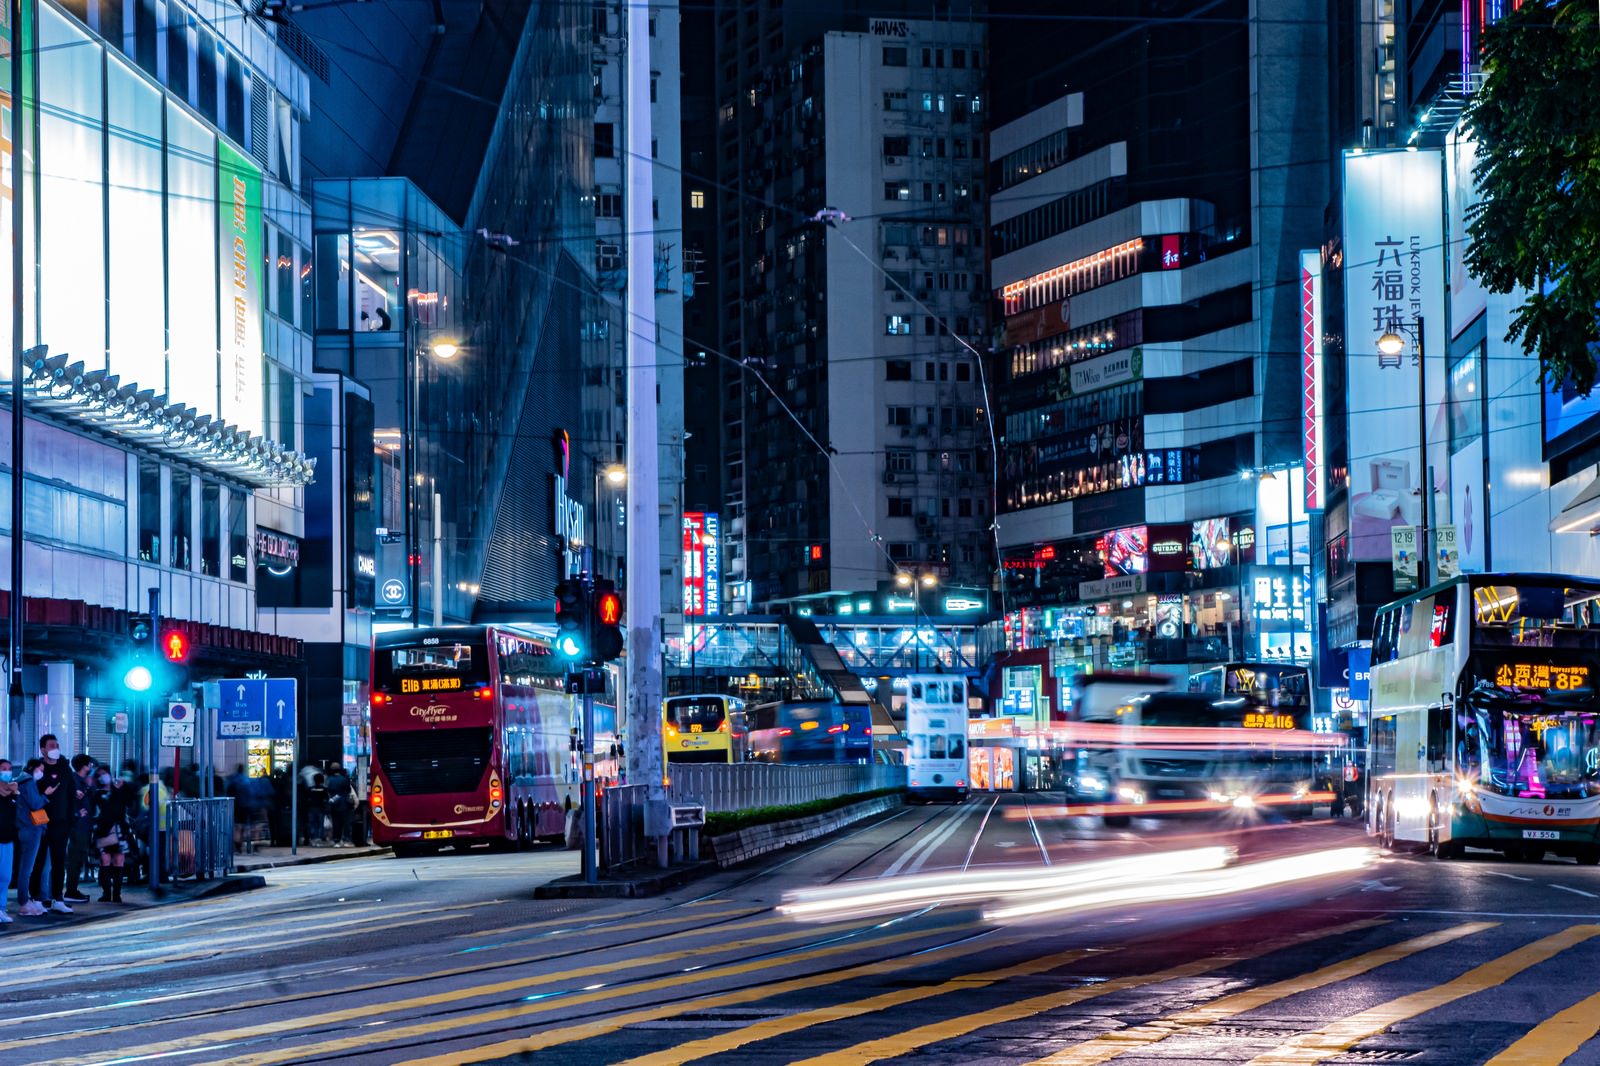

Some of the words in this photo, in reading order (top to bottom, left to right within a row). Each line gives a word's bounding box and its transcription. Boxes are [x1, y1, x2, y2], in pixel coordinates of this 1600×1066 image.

[1409, 235, 1420, 295] LUKFOOK
[1497, 664, 1550, 679] 小西灣
[1556, 673, 1583, 690] 8P
[1277, 715, 1293, 728] 116
